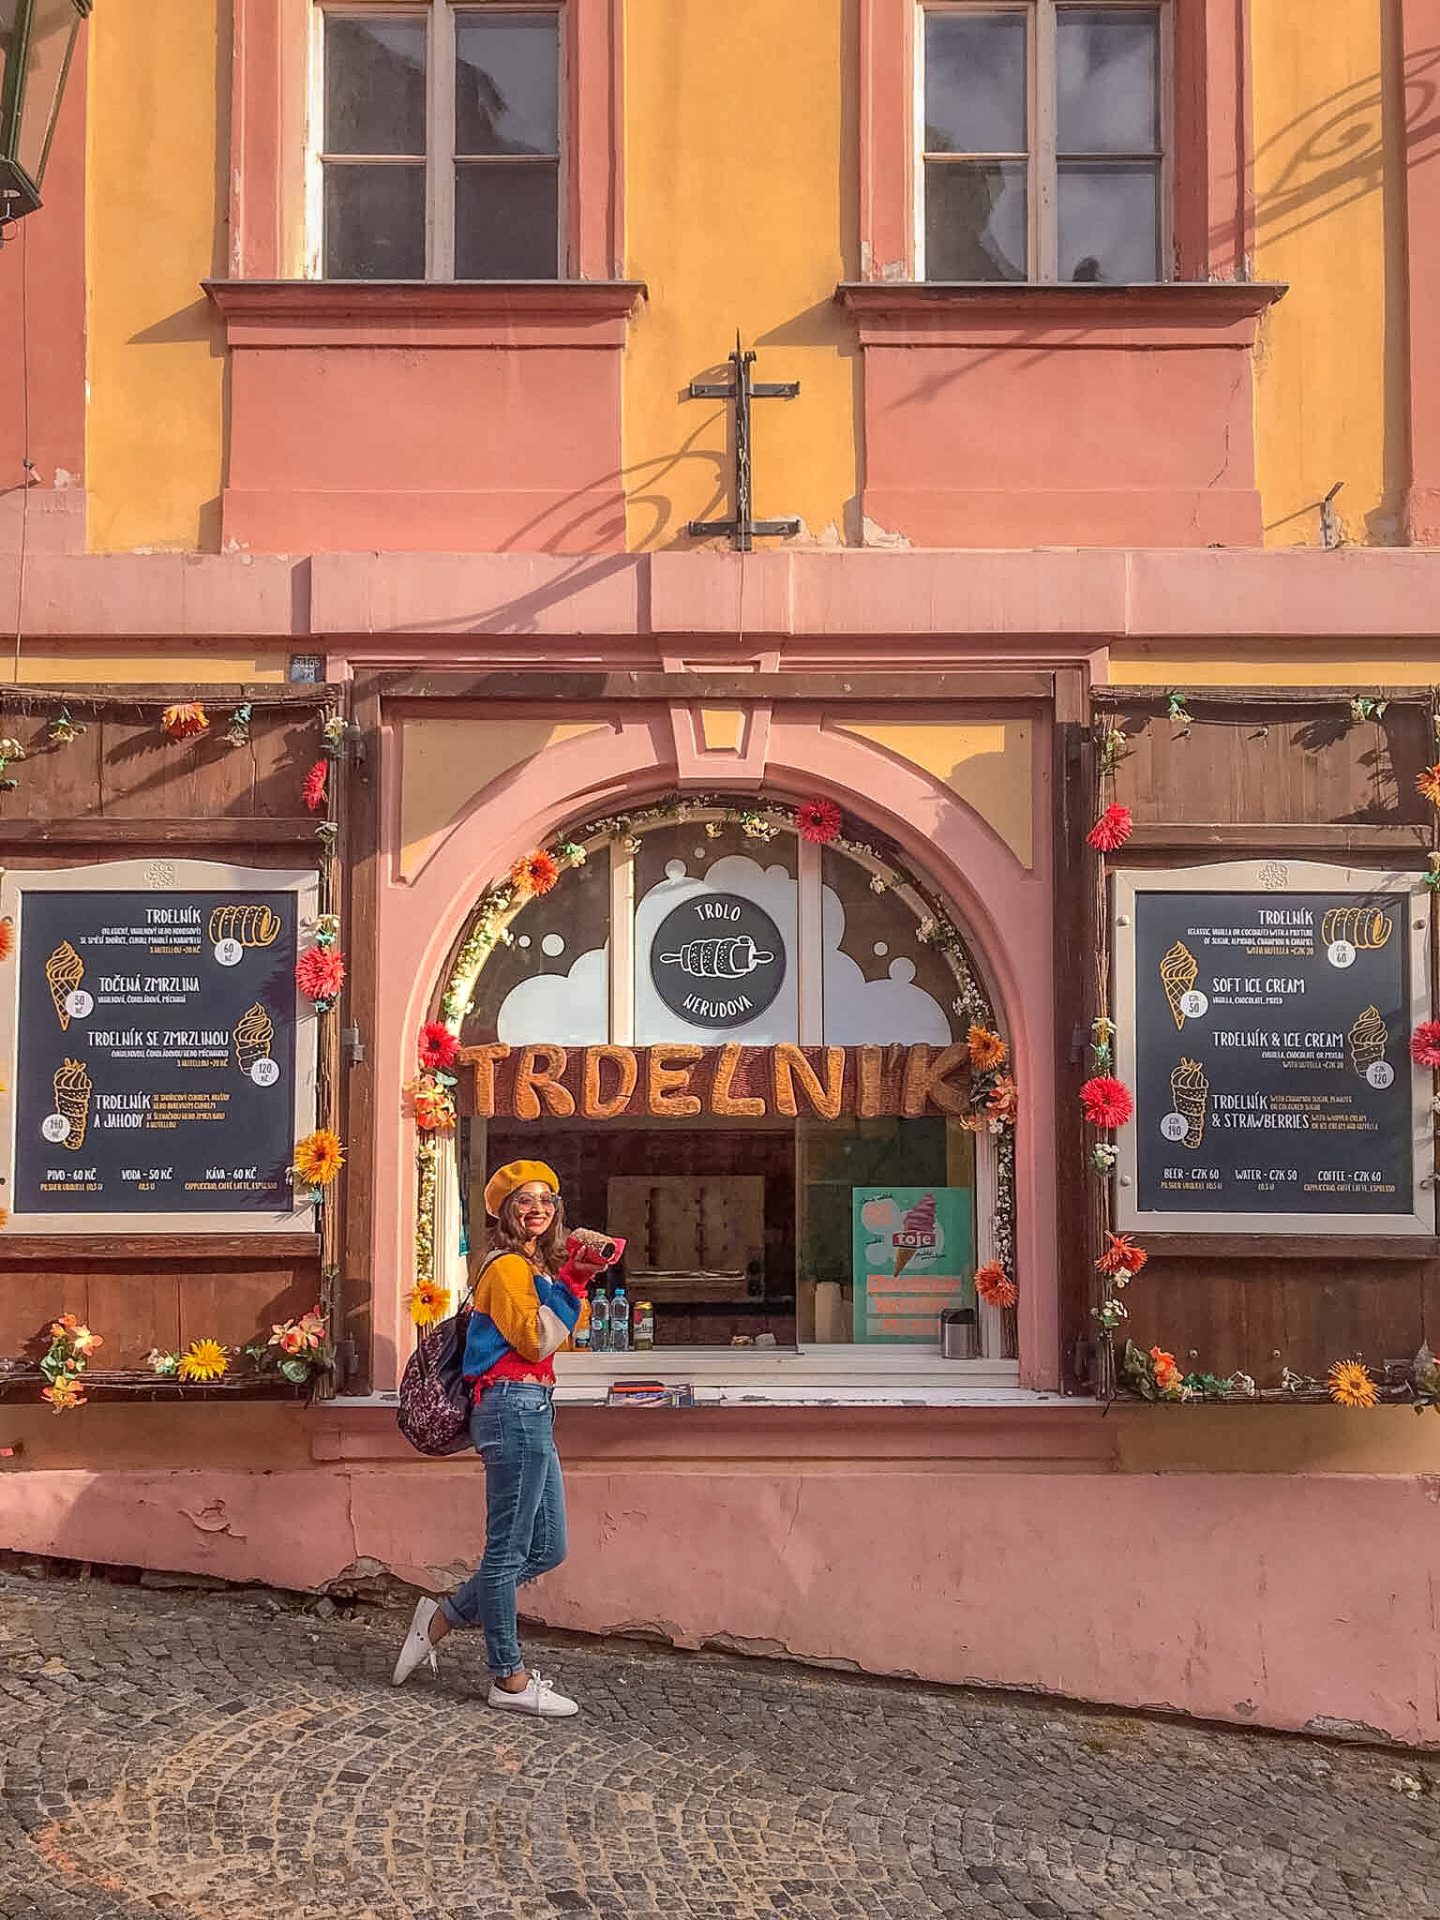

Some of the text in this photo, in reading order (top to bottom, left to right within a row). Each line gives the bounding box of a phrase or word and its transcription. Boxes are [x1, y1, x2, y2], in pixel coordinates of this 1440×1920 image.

[145, 906, 202, 924] TRDELNÍK
[694, 903, 741, 921] TRDLO
[1258, 908, 1314, 924] TRDELNÍK
[224, 943, 234, 953] 60
[98, 974, 200, 992] TOČENÁ ZMRZLINA
[1213, 978, 1305, 993] SOFT ICE CREAM
[75, 995, 84, 1006] 50
[683, 994, 753, 1018] NERUDOVA
[1189, 1002, 1200, 1012] 50
[87, 1028, 229, 1046] TRDELNÍK SE ZMRZLINOU
[1212, 1028, 1344, 1048] TRDELNÍK & ICE CREAM
[260, 1063, 272, 1073] 120
[1374, 1073, 1387, 1084] 120
[95, 1091, 150, 1109] TRDELNÍK
[1211, 1091, 1268, 1110] TRDELNÍK
[94, 1114, 100, 1128] A
[104, 1114, 144, 1128] JAHODY
[1212, 1113, 1309, 1128] & STRAWBERRIES
[47, 1170, 66, 1180] PIVO
[73, 1170, 83, 1180] 60
[84, 1168, 97, 1180] KČ
[122, 1170, 141, 1180] VODA
[149, 1170, 159, 1180] 50
[161, 1168, 173, 1180] KČ
[206, 1166, 225, 1180] KÁVA
[233, 1169, 244, 1180] 60
[244, 1166, 257, 1180] KČ
[1164, 1168, 1184, 1180] BEER
[1192, 1168, 1208, 1180] CZK
[1209, 1168, 1220, 1180] 60
[1234, 1170, 1262, 1180] WATER
[1269, 1170, 1284, 1180] CZK
[1287, 1170, 1298, 1180] 50
[1318, 1170, 1346, 1181] COFFEE
[1354, 1170, 1370, 1181] CZK
[1371, 1170, 1381, 1181] 60
